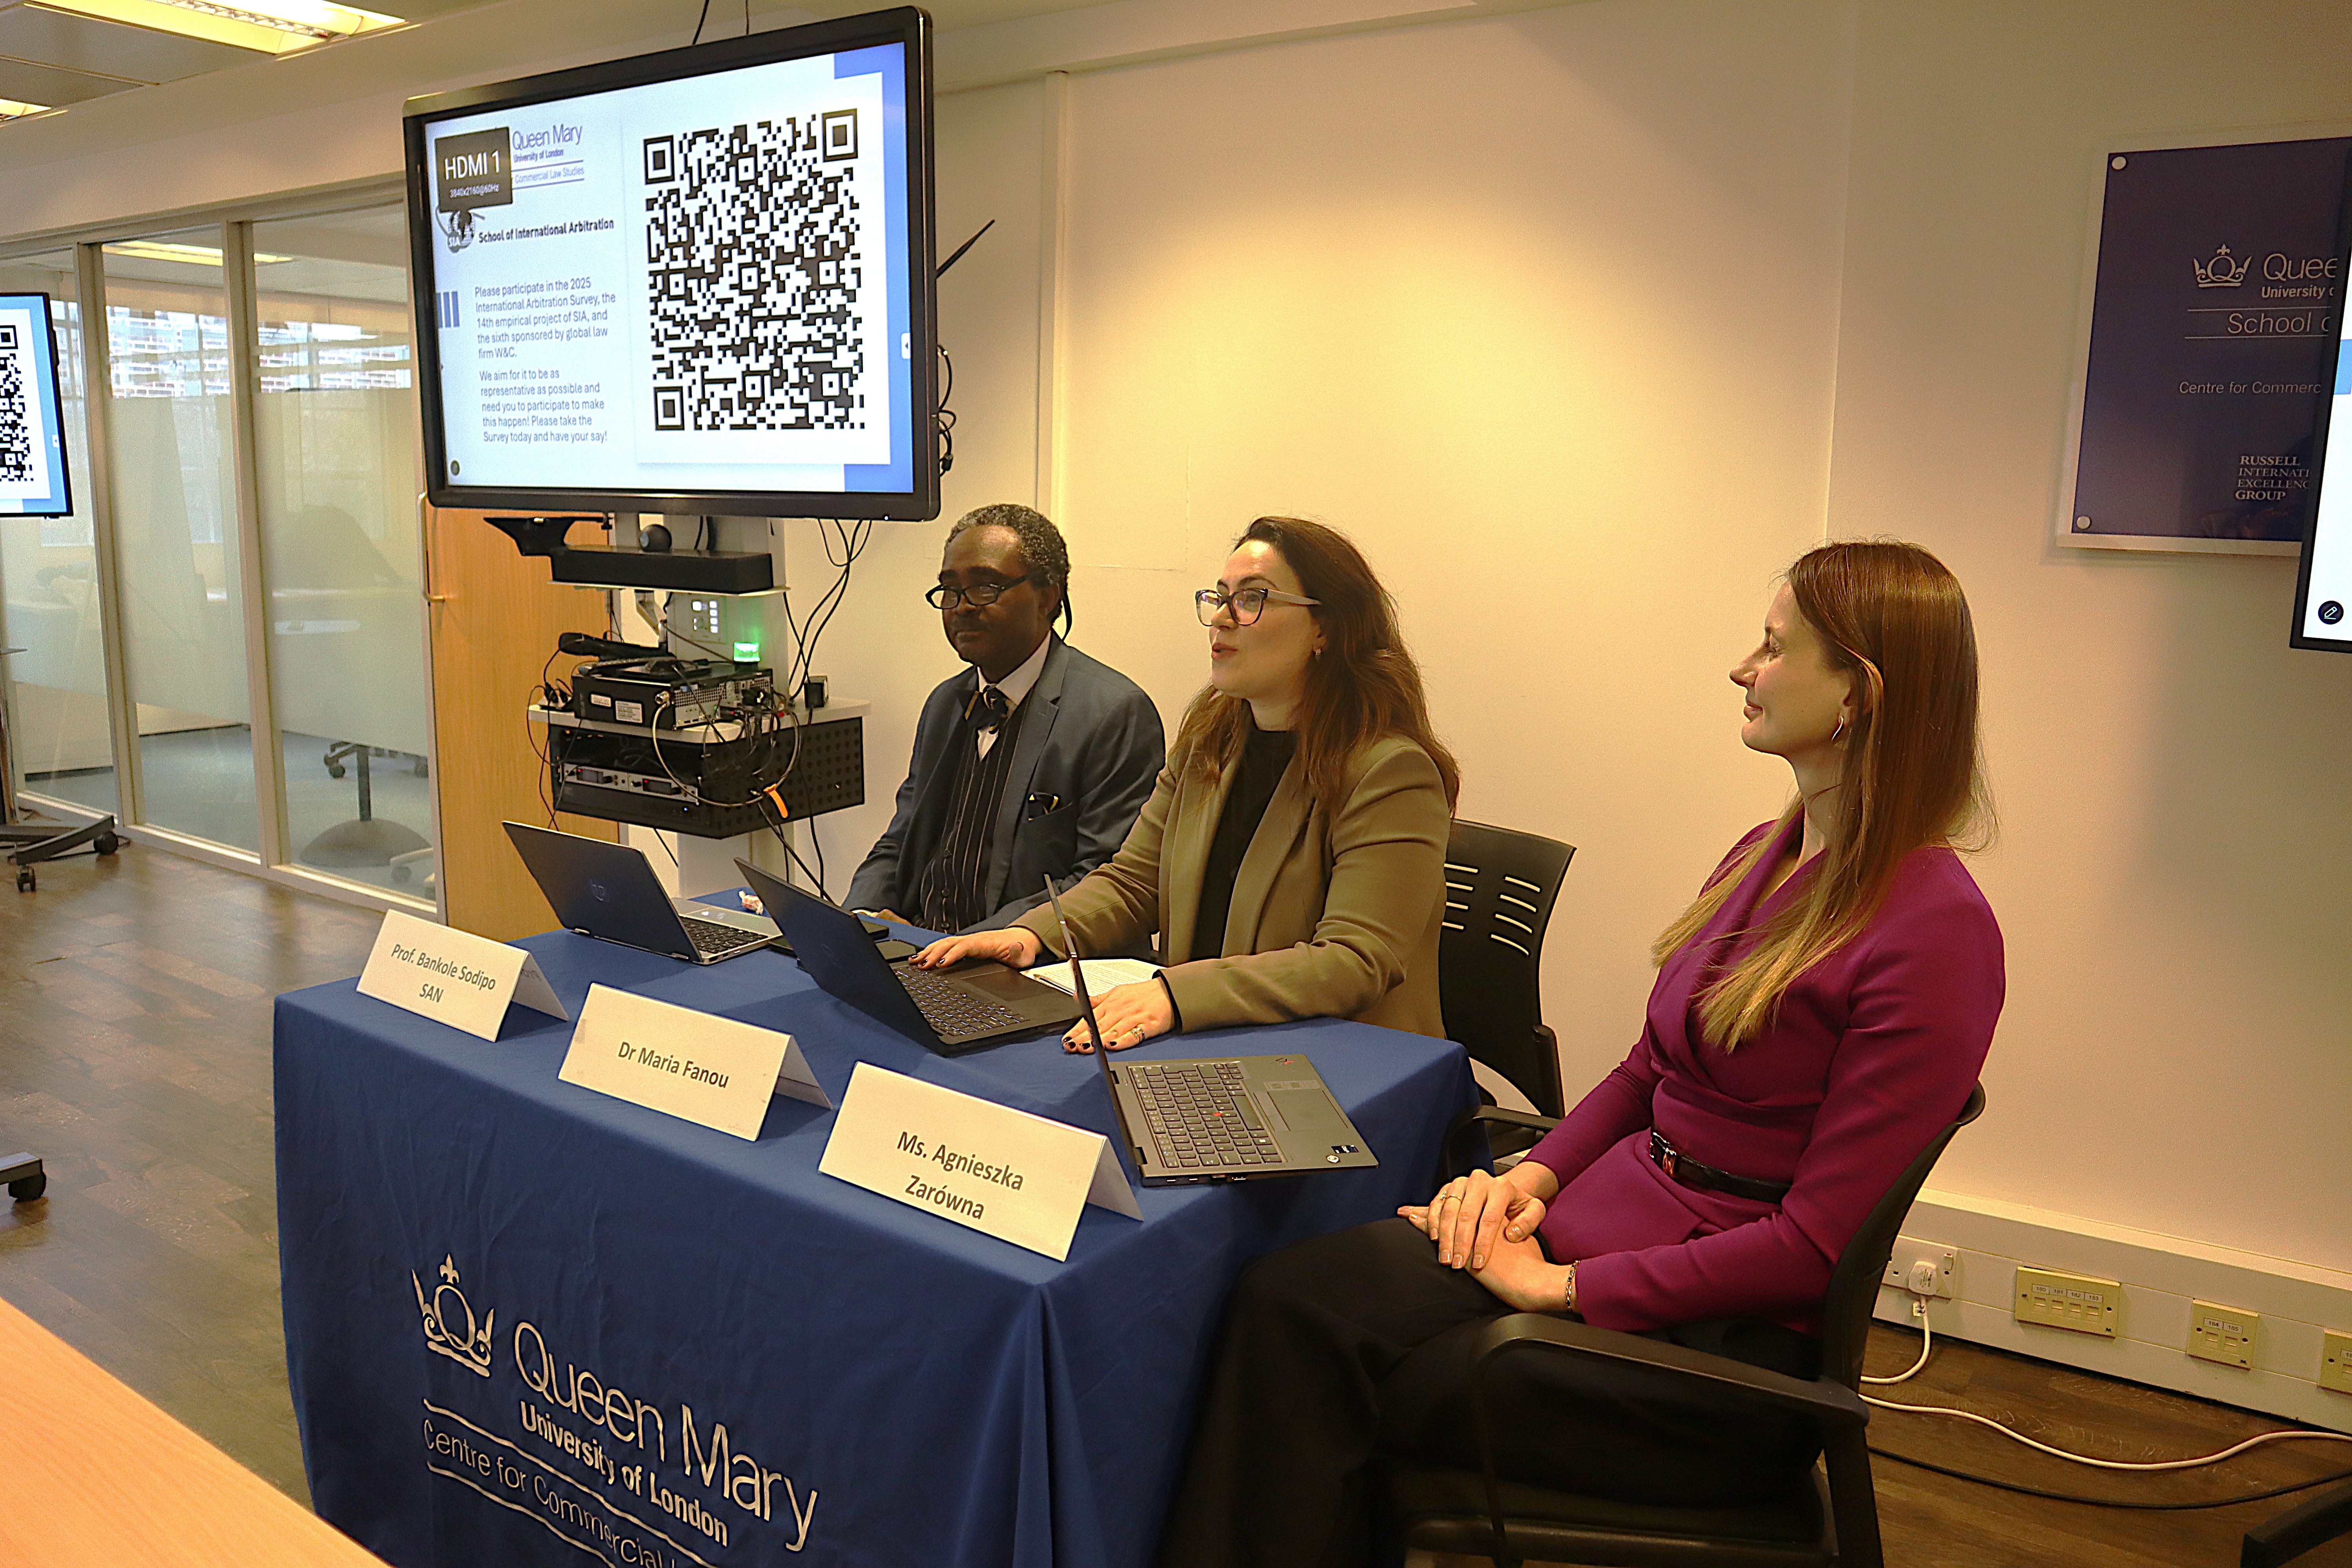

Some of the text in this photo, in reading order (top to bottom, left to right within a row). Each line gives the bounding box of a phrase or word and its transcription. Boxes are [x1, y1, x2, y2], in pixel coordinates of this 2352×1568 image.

[512, 123, 583, 151] Queen Mary
[445, 150, 500, 180] HDMI 1
[514, 148, 564, 163] University of London
[515, 167, 584, 183] Commercial Law Studies
[479, 218, 614, 243] School of International Arbitration
[475, 276, 591, 298] Please participate in the 2025
[2261, 285, 2326, 299] University
[475, 292, 615, 313] International Arbitration Survey, the
[477, 309, 608, 328] 14th empirical project of SIA, and
[2228, 312, 2312, 334] School
[477, 326, 608, 344] the sixth sponsored by global law
[478, 347, 517, 359] firm W&C.
[479, 368, 559, 381] We aim for it to be as
[481, 382, 600, 399] representative as possible and
[2180, 381, 2321, 394] Centre for Commerc
[482, 399, 604, 414] need you to participate to make
[483, 415, 592, 429] this happen! Please take the
[483, 430, 607, 444] Survey today and have your say!
[2239, 456, 2300, 465] RUSSELL
[2238, 468, 2310, 477] INTERNATI
[2235, 490, 2286, 501] GROUP
[391, 944, 416, 964] Prof.
[417, 952, 457, 977] Bankole
[458, 966, 495, 990] Sodipo
[419, 983, 444, 1003] SAN
[618, 1042, 730, 1089] Dr Maria Fanou
[897, 1131, 1024, 1191] Ms. Agnieszka
[905, 1175, 984, 1220] Zarówna
[514, 1321, 818, 1552] Queen Mary
[521, 1401, 727, 1547] University of London
[424, 1419, 662, 1568] Centre for Commercial
